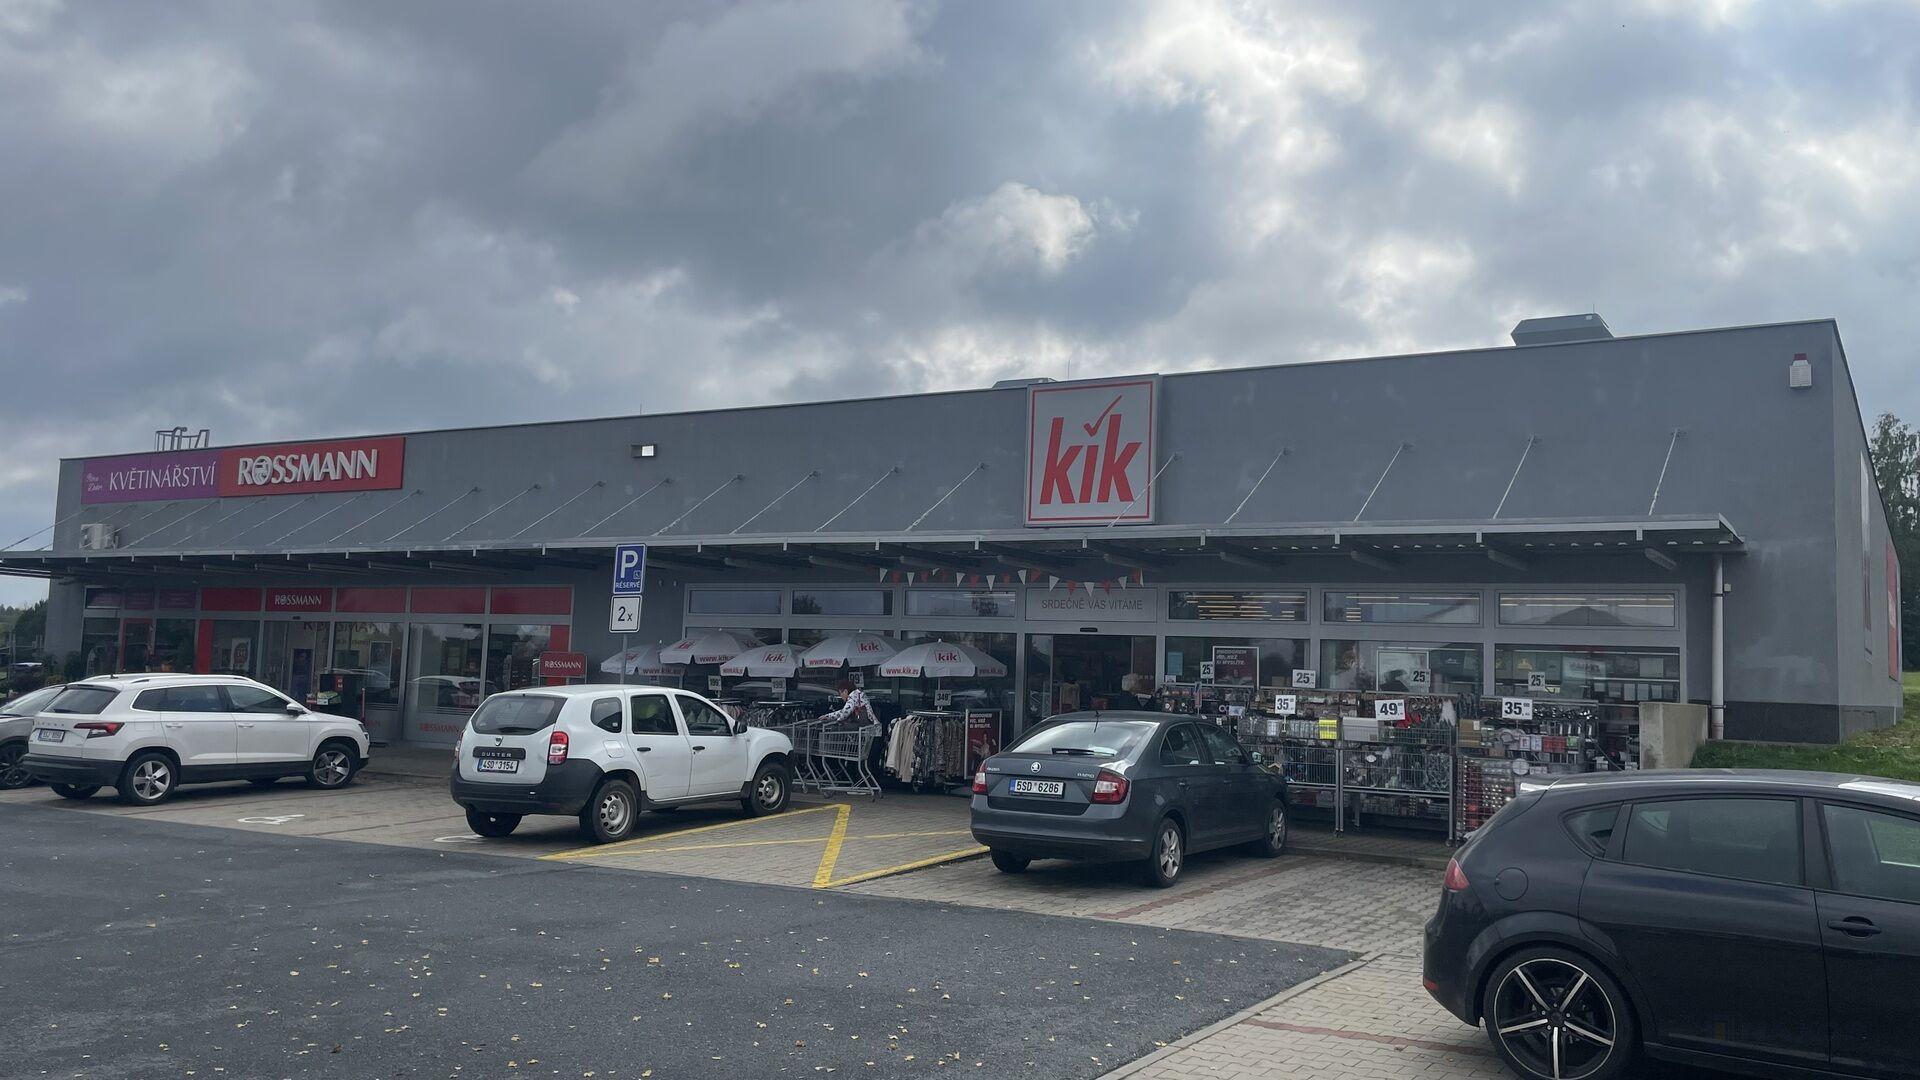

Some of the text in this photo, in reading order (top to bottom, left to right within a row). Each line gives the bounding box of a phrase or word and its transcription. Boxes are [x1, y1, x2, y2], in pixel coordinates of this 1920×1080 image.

[1040, 395, 1142, 504] kik
[238, 449, 378, 485] ROSSMANN
[109, 461, 216, 491] KVĚTINÁŘSTVÍ
[620, 550, 639, 578] P
[615, 581, 641, 589] RÉSERVÉ
[274, 595, 321, 605] ROSSMANN
[1041, 597, 1143, 610] SRDEČNĚ VÁS VÍTÁME
[860, 642, 880, 652] kik
[764, 653, 785, 663] kik
[937, 652, 958, 662] kik
[544, 660, 582, 669] ROSSMANN
[1296, 672, 1310, 684] 25
[1413, 671, 1426, 682] 25
[1531, 675, 1541, 687] 25
[1277, 698, 1289, 710] 35
[1380, 703, 1398, 715] 49
[1505, 702, 1523, 715] 35
[498, 761, 514, 770] 3154
[1016, 781, 1059, 793] 5SD 6286
